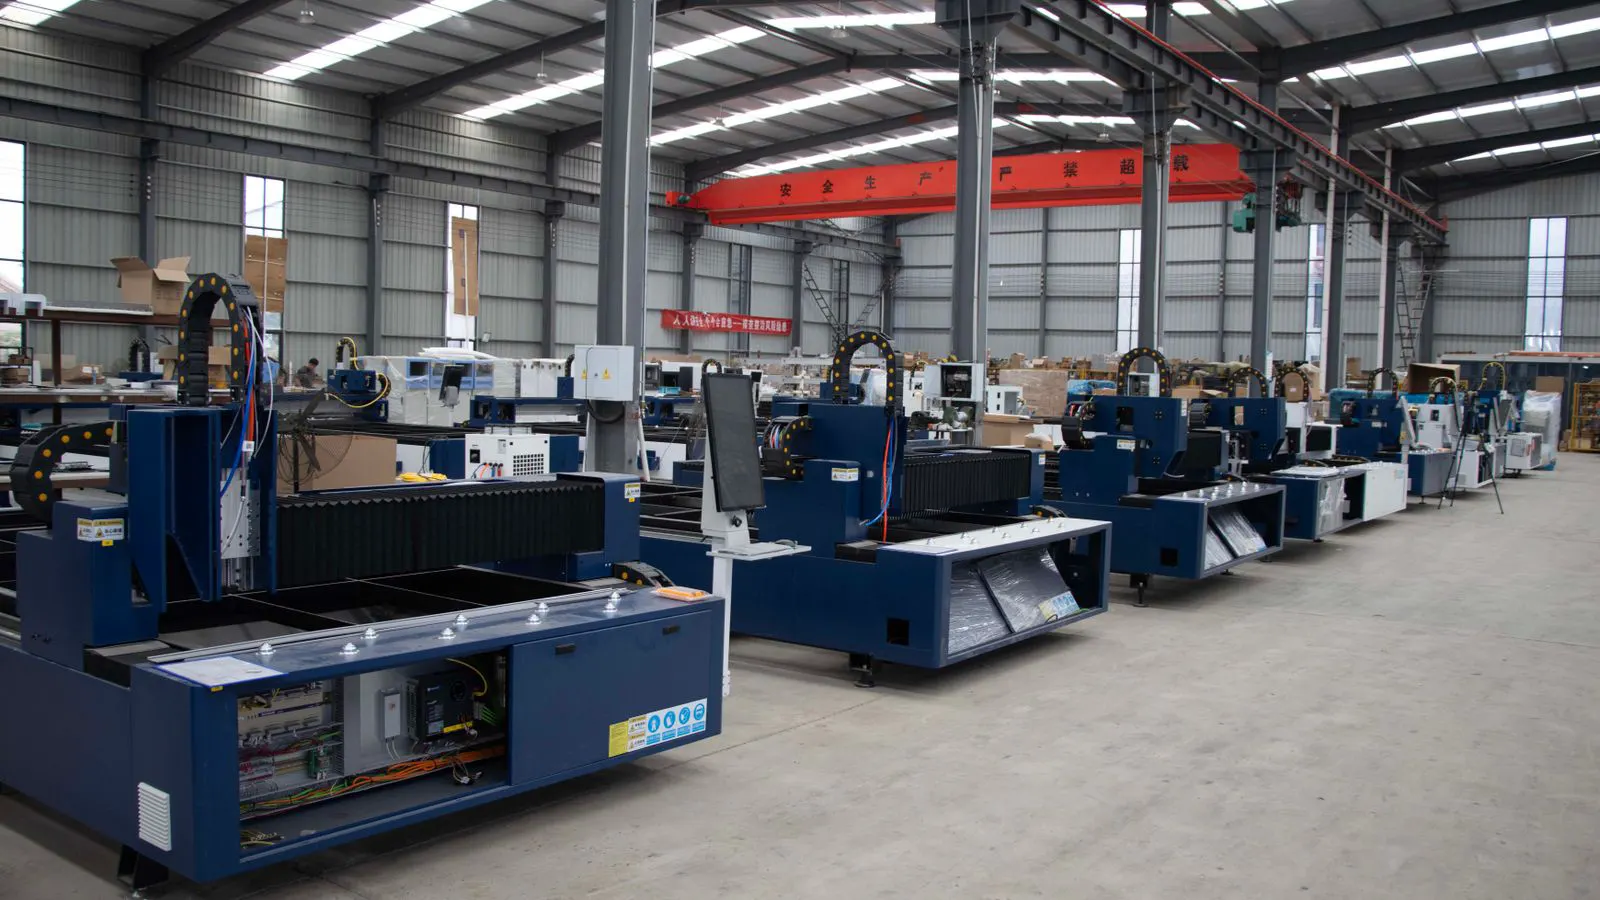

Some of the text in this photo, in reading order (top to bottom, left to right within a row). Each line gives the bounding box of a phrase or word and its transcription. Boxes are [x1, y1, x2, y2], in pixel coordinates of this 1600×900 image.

[779, 155, 1190, 198] 安全生产 严禁超载
